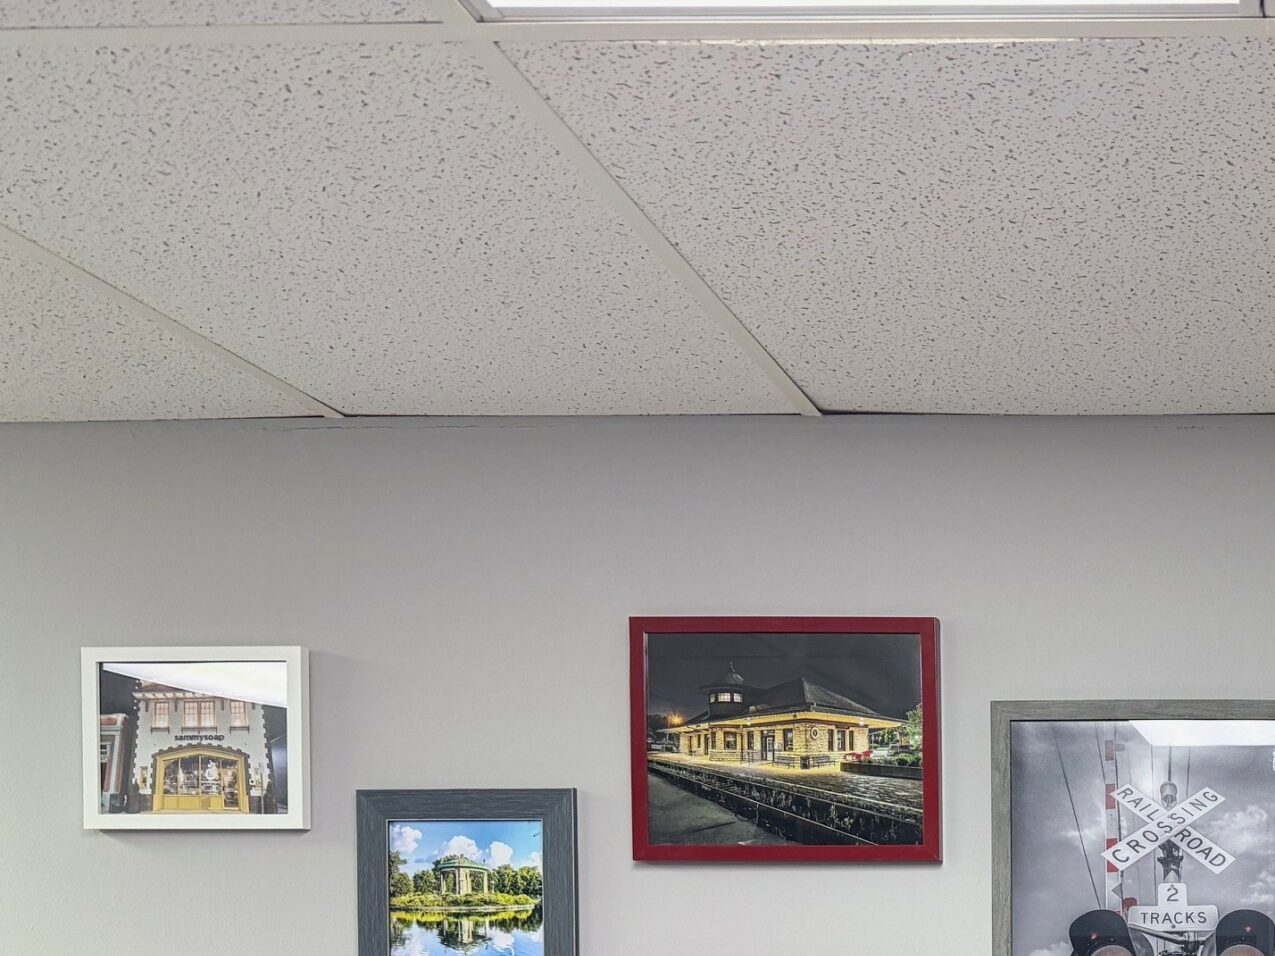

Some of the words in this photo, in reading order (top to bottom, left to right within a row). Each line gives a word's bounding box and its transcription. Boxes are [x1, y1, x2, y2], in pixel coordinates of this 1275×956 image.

[1111, 791, 1218, 863] CROSSING
[1166, 887, 1179, 902] 2
[1140, 911, 1207, 924] TRACKS
